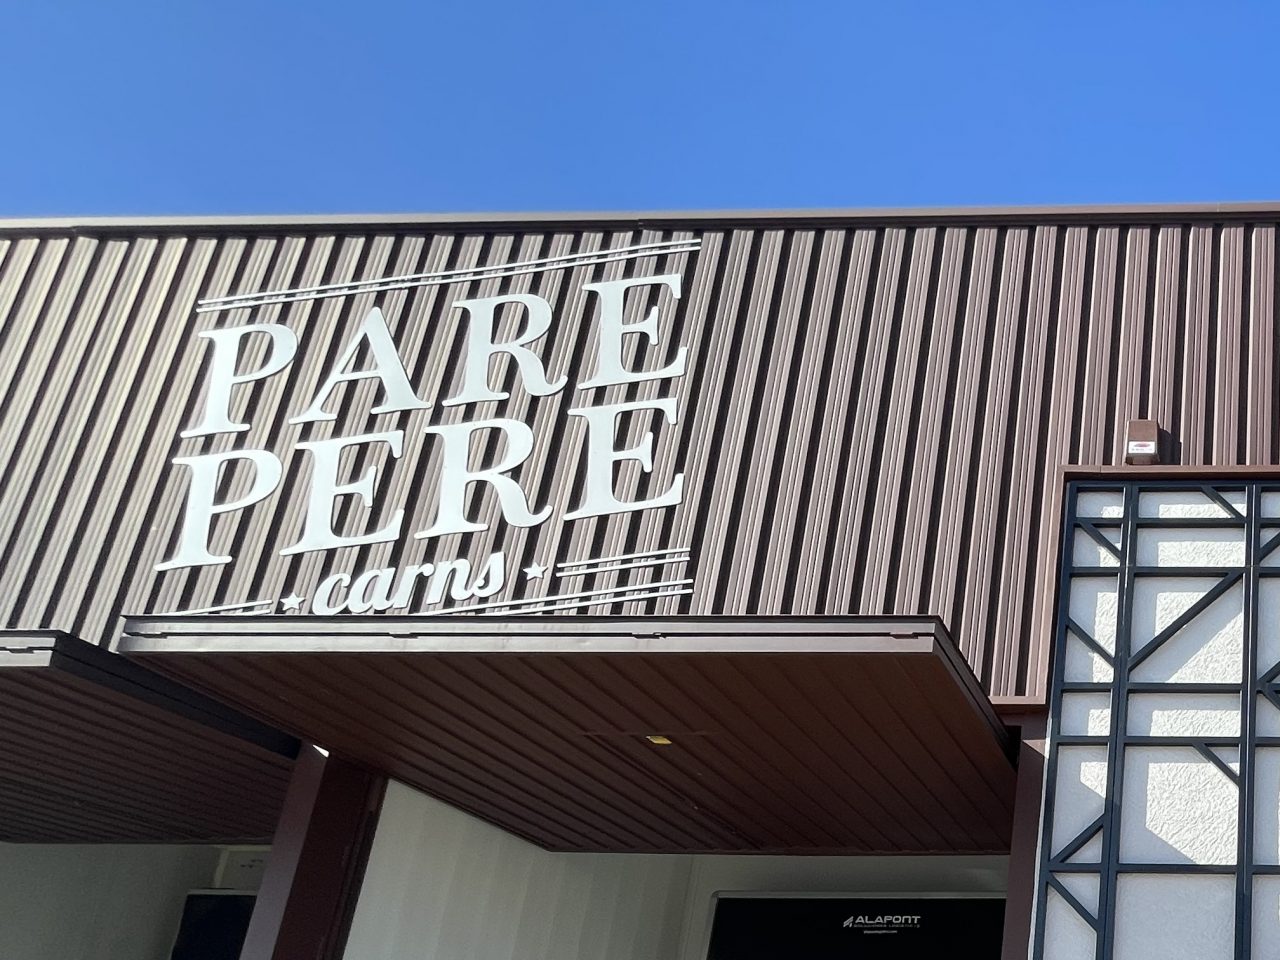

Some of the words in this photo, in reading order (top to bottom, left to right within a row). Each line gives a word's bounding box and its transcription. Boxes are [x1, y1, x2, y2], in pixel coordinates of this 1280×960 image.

[180, 273, 688, 439] PARE
[155, 397, 685, 571] PERE
[312, 552, 505, 616] carns
